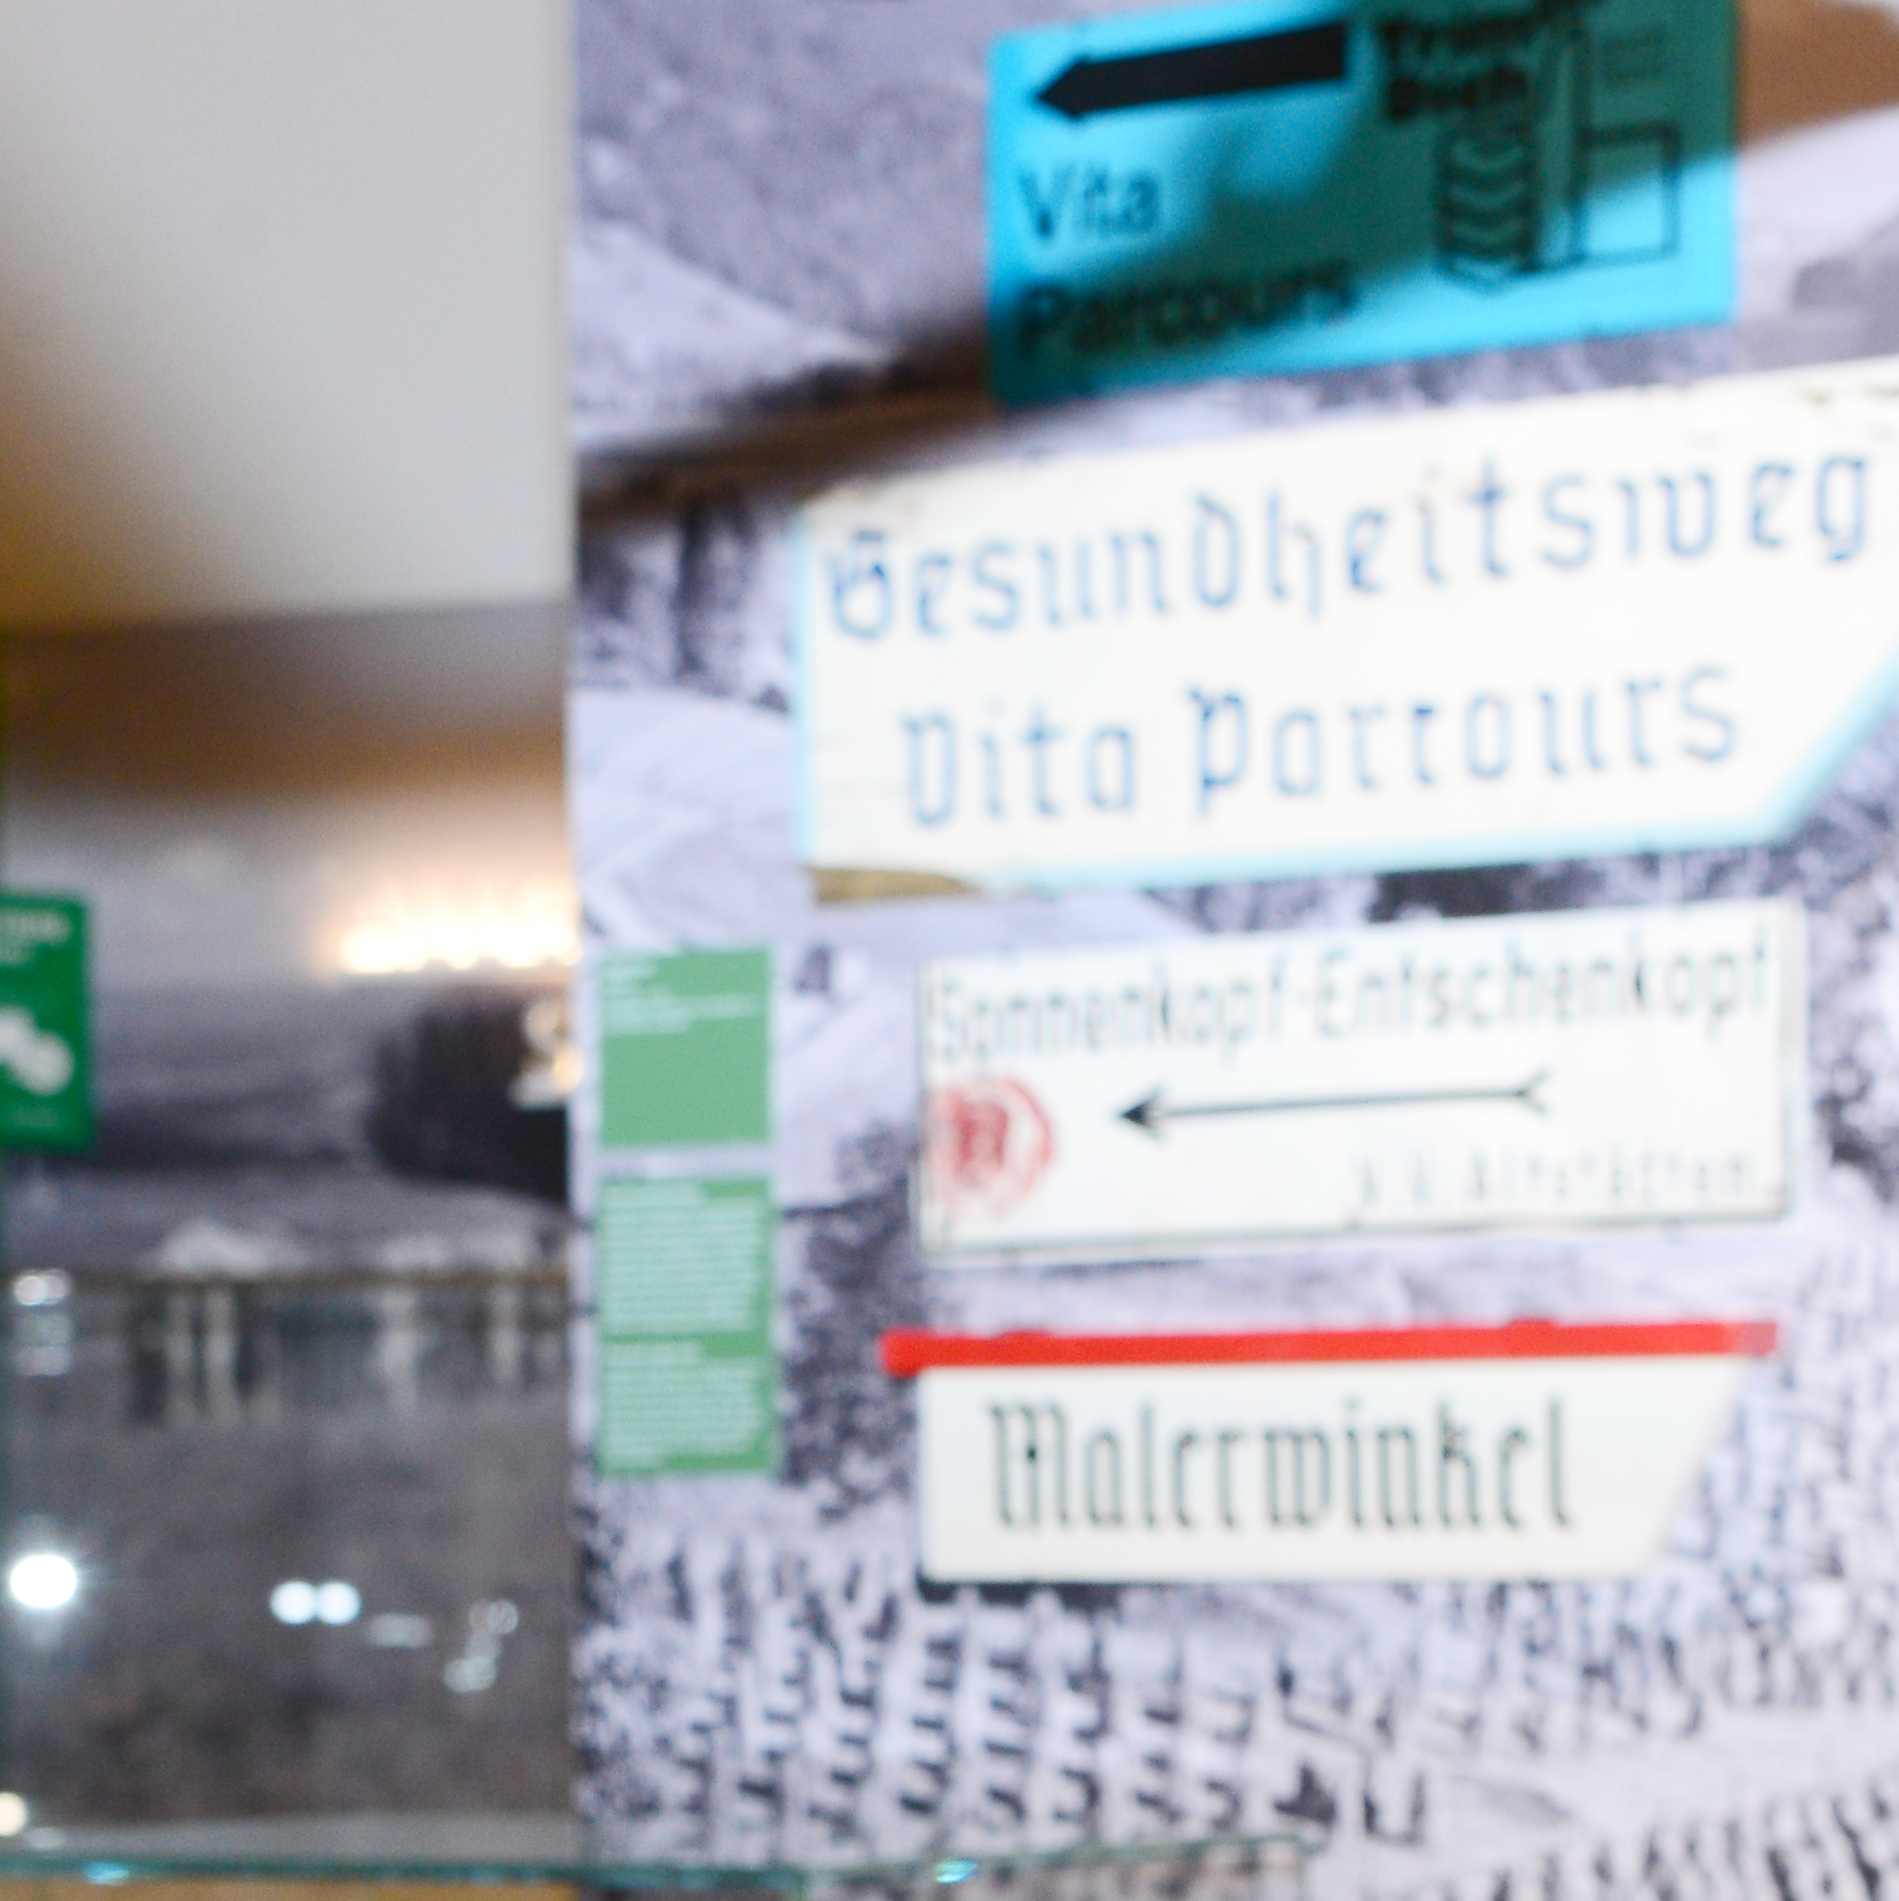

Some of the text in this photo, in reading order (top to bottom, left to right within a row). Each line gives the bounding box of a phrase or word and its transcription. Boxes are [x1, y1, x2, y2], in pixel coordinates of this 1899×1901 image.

[1016, 160, 1162, 246] Vita
[827, 447, 1872, 640] Gesundheitsweg
[902, 662, 1740, 828] Vita Parcours
[984, 1398, 1576, 1532] Malerwinkel
